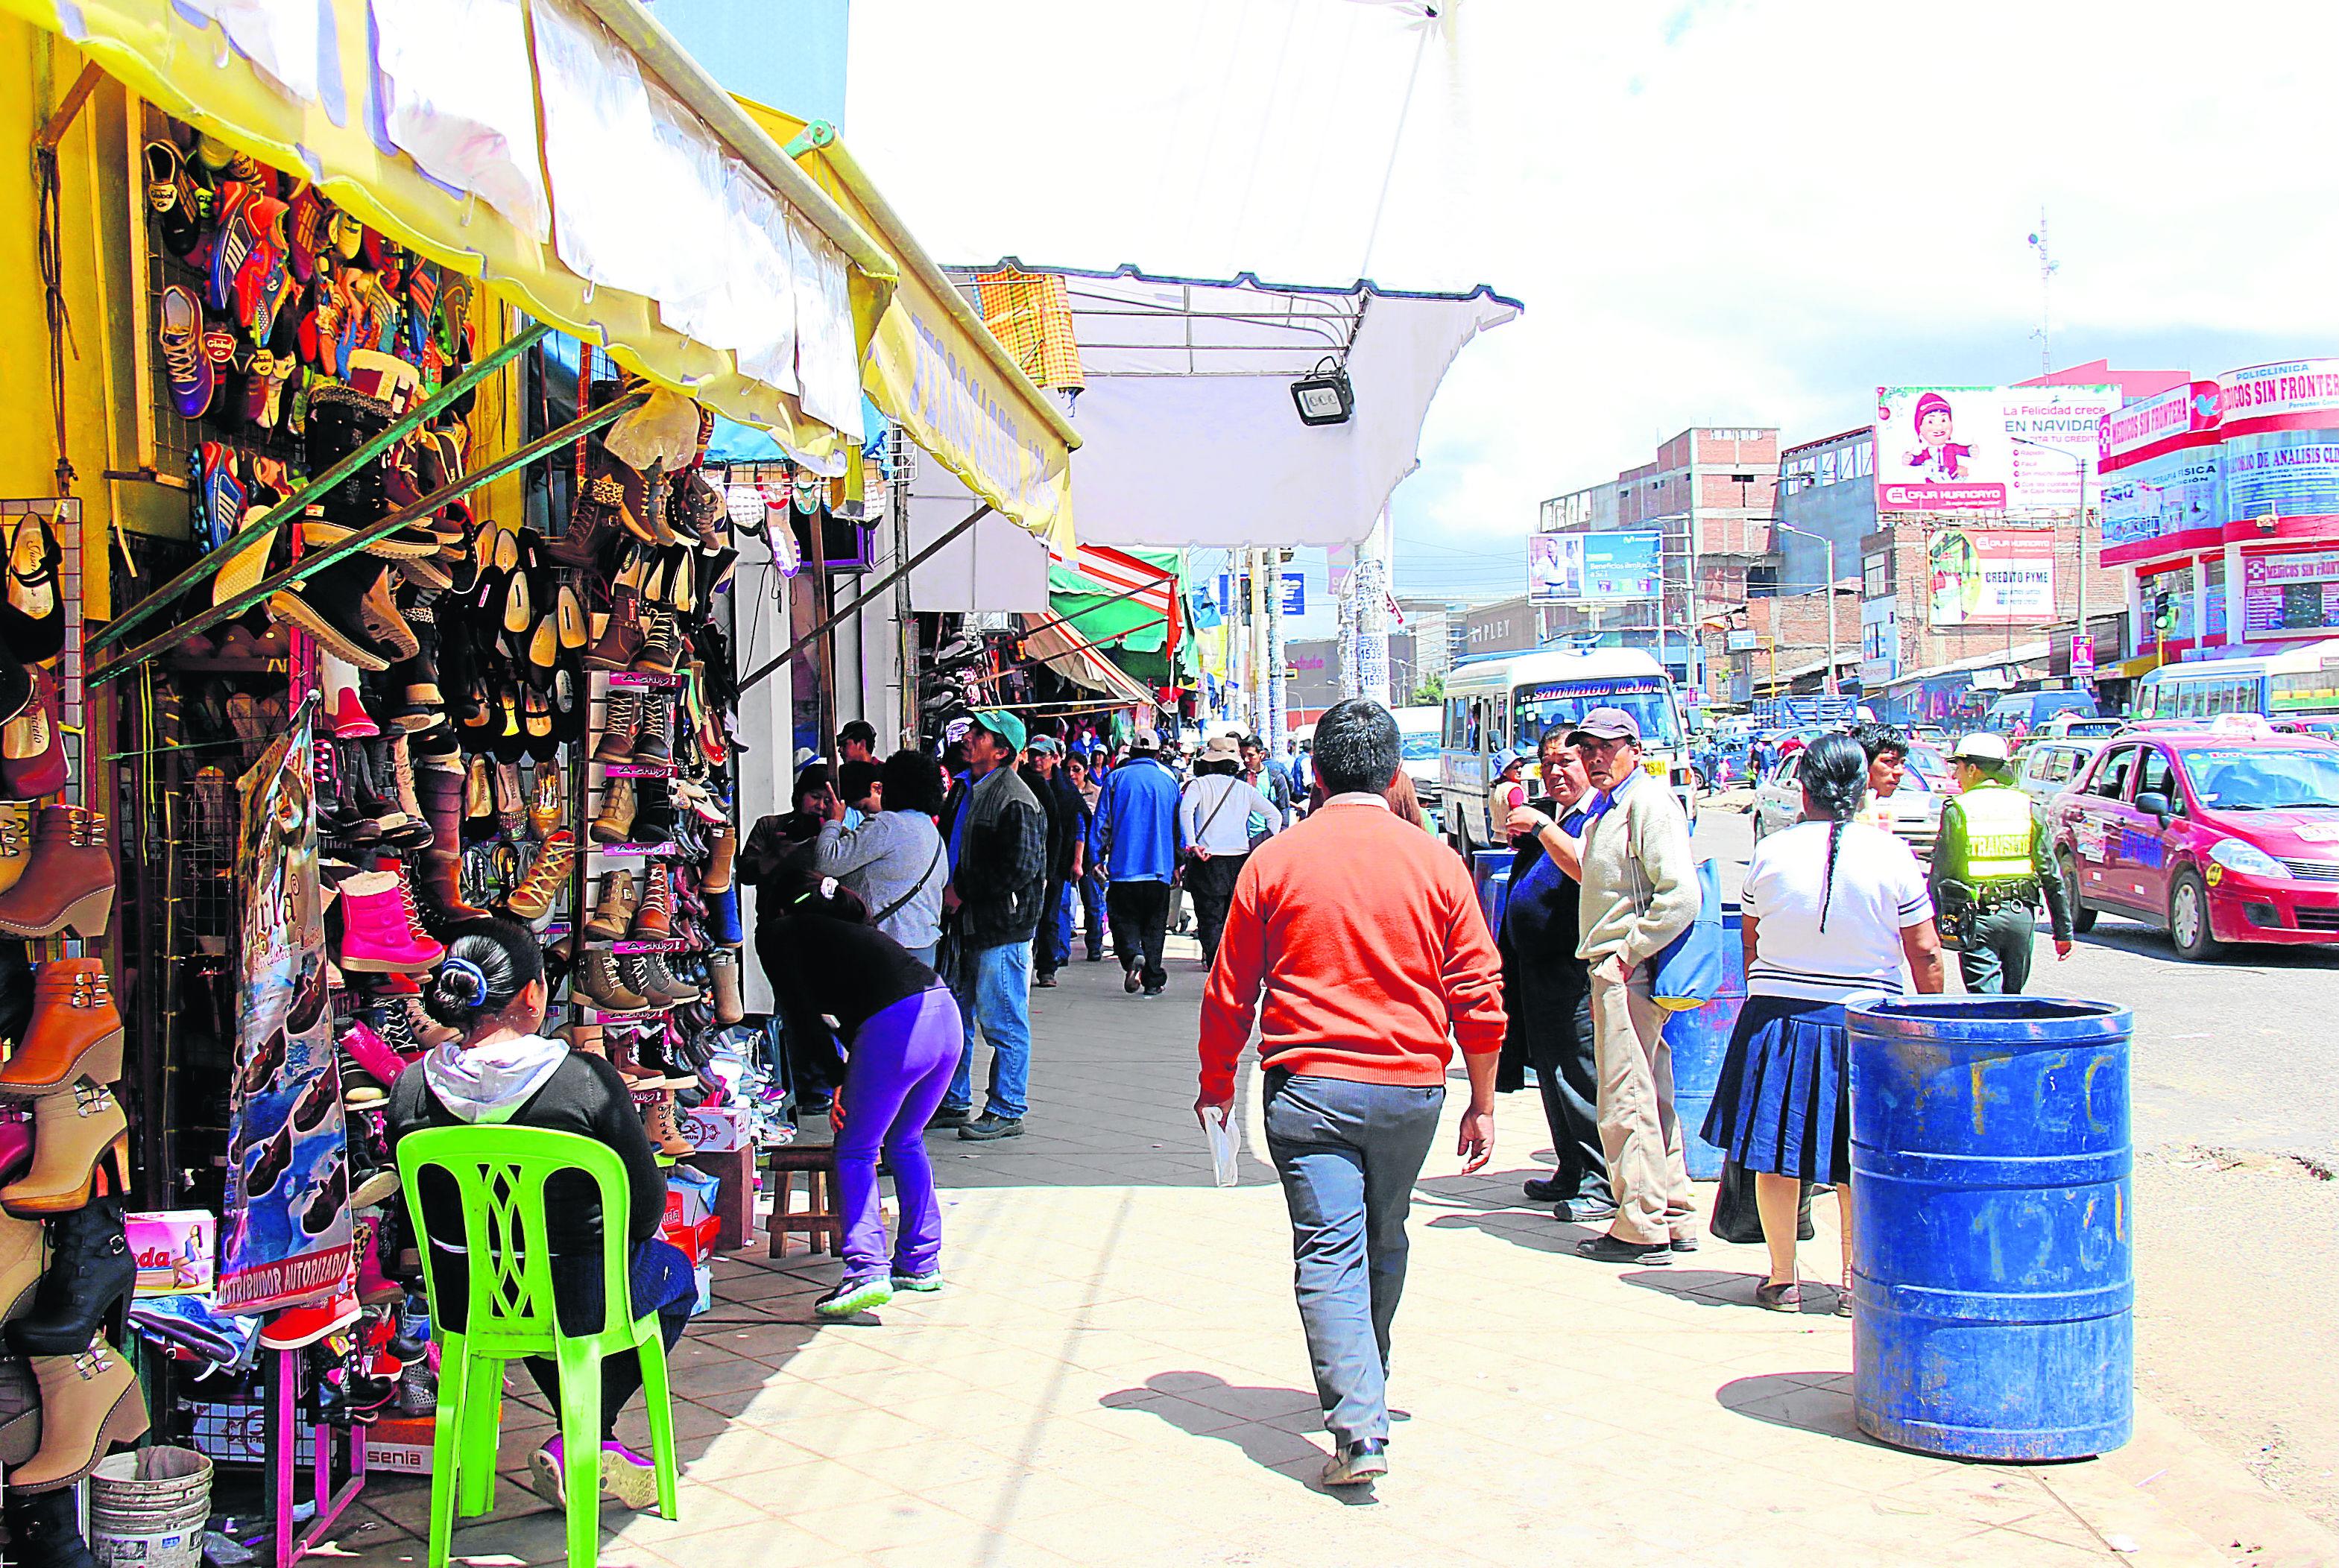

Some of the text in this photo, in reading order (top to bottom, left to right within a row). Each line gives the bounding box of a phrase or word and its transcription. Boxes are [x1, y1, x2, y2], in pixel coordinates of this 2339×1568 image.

[207, 339, 233, 350] Global
[2236, 364, 2309, 381] POLICLINICA
[2255, 379, 2276, 405] SIN
[2004, 406, 2106, 415] La Felicidad crece
[2005, 420, 2026, 431] EN
[2257, 452, 2270, 469] DE
[2273, 448, 2320, 466] ANALISIS
[1907, 490, 2001, 499] CAJA HUANCAYO
[2025, 572, 2048, 583] PYME
[1471, 619, 1510, 643] RIPLEY
[1368, 639, 1383, 648] 993
[1371, 666, 1386, 674] 993
[1532, 682, 1611, 701] SANTIAGO
[1968, 835, 2030, 857] TRANSITO
[219, 1251, 348, 1305] DISTRIBUIDOR AUTORIZADO
